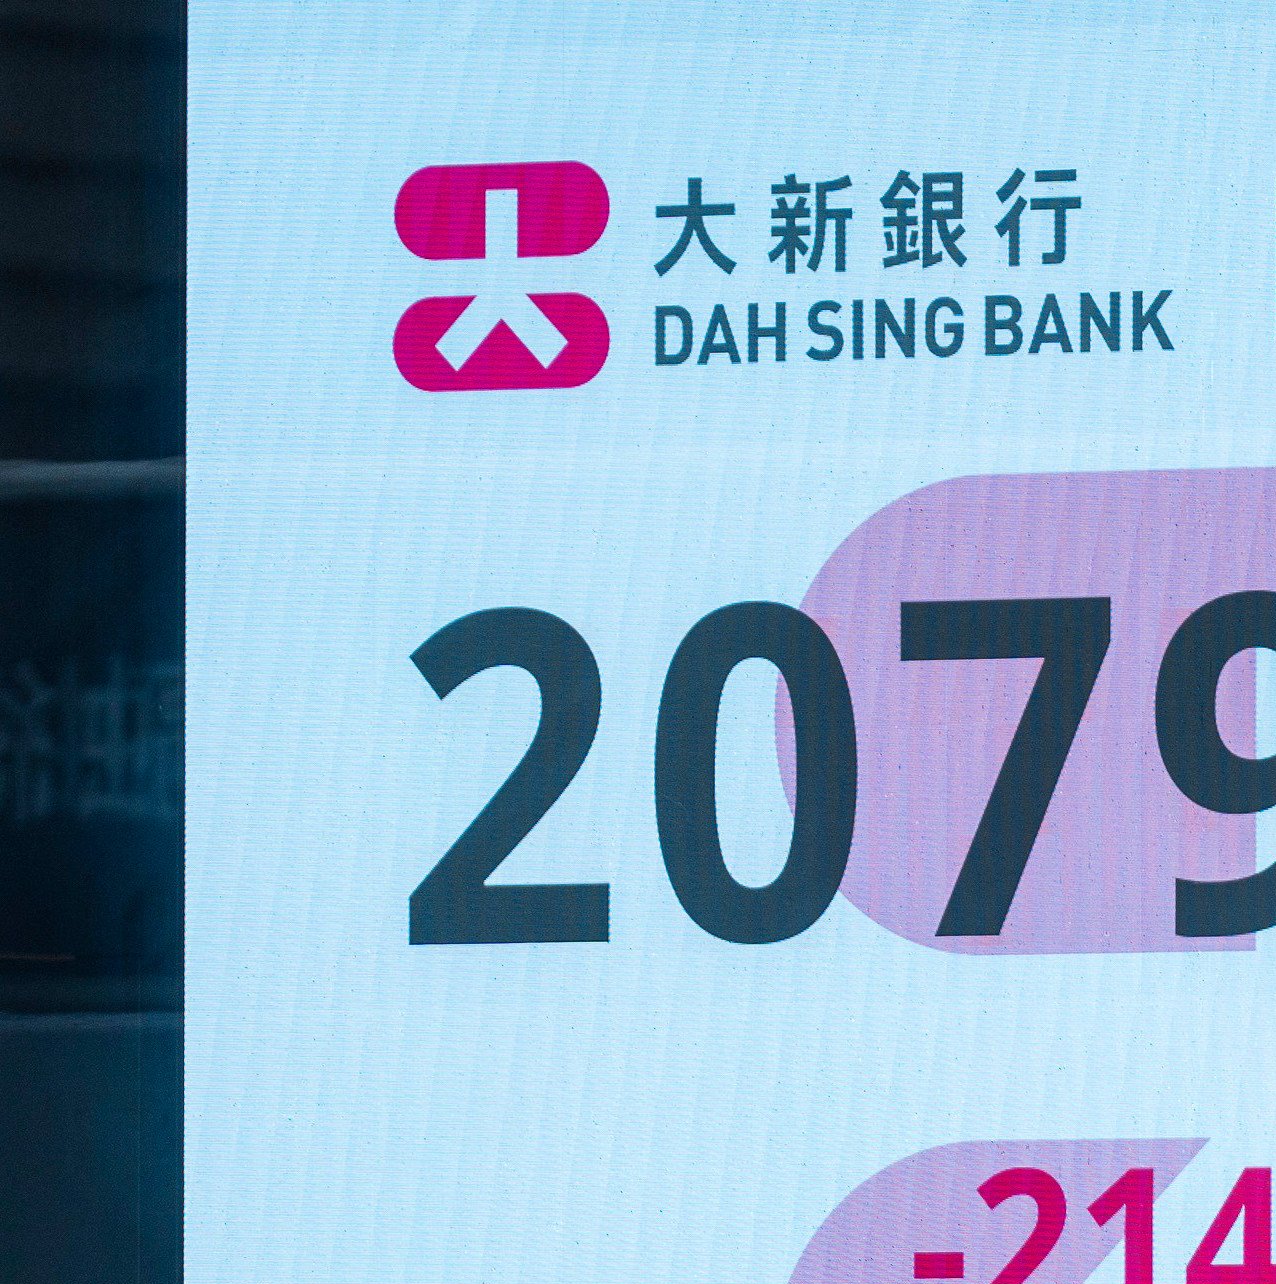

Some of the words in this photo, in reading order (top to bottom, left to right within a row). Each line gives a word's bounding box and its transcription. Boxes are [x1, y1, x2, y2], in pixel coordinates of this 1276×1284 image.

[654, 167, 1083, 277] 大新銀行
[654, 301, 788, 367] DAH
[806, 296, 965, 362] SING
[984, 288, 1175, 357] BANK
